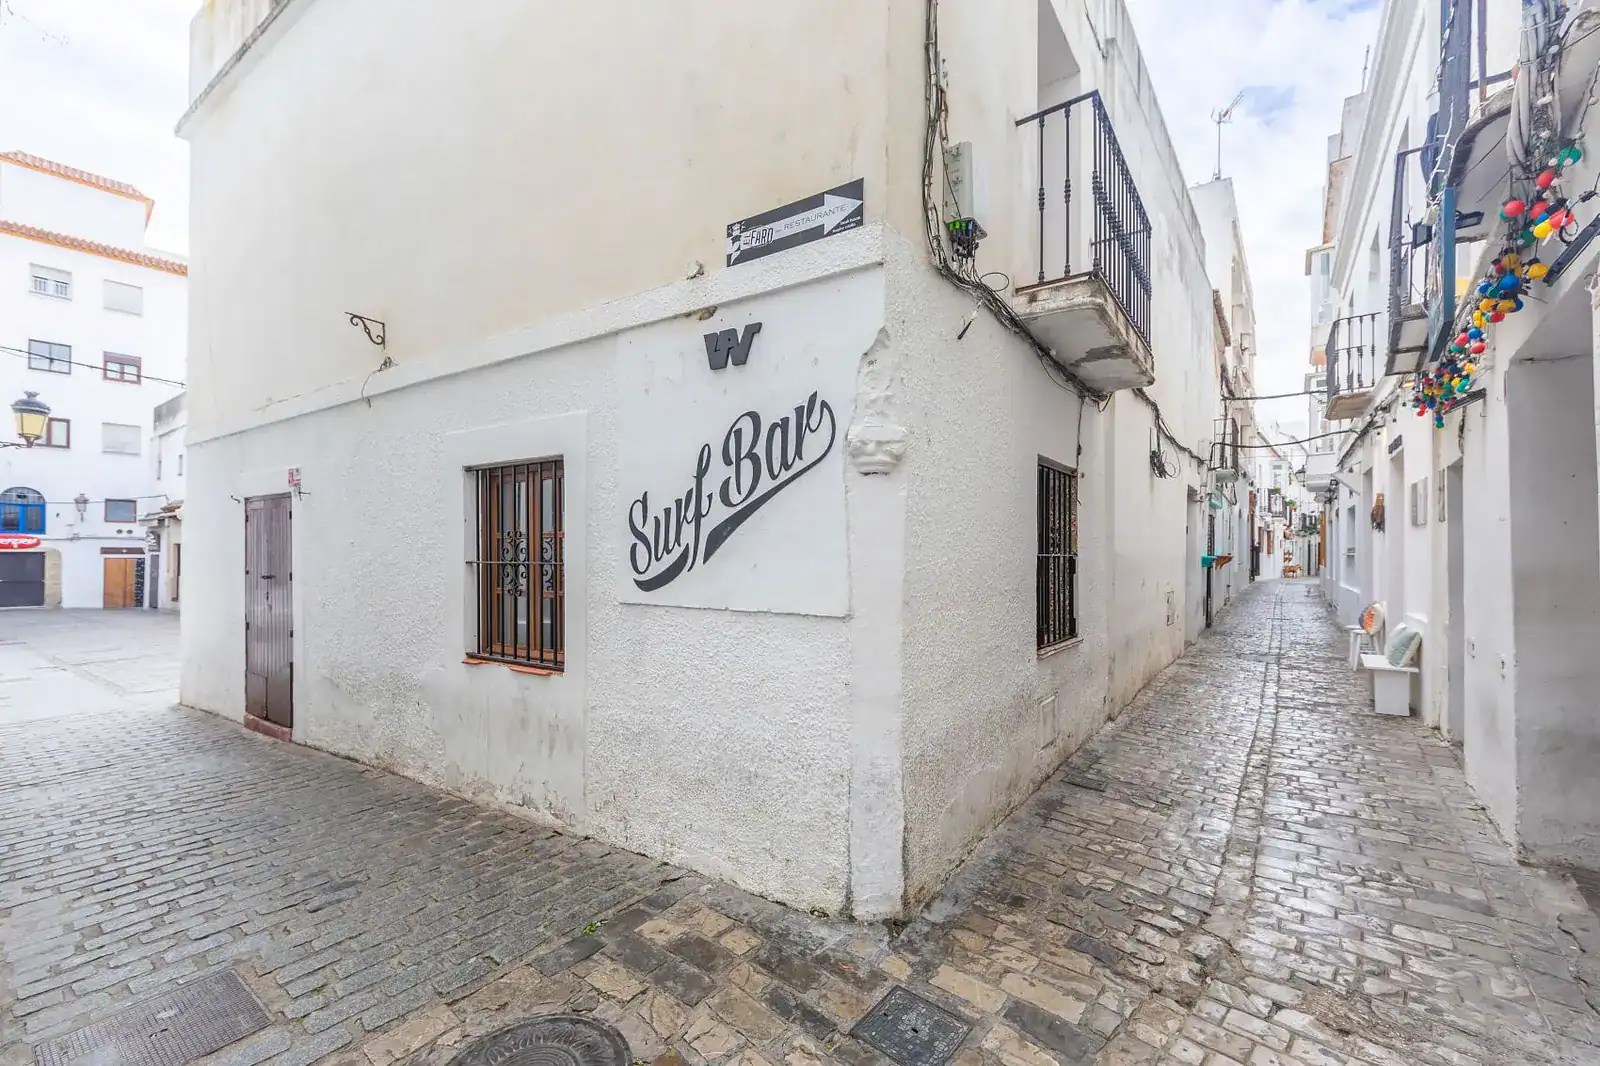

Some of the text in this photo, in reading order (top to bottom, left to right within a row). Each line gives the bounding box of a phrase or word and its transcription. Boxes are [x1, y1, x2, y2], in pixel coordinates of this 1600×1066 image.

[783, 203, 848, 231] RESTAURANTE
[750, 227, 774, 246] FARO
[628, 390, 836, 577] Surf Bar
